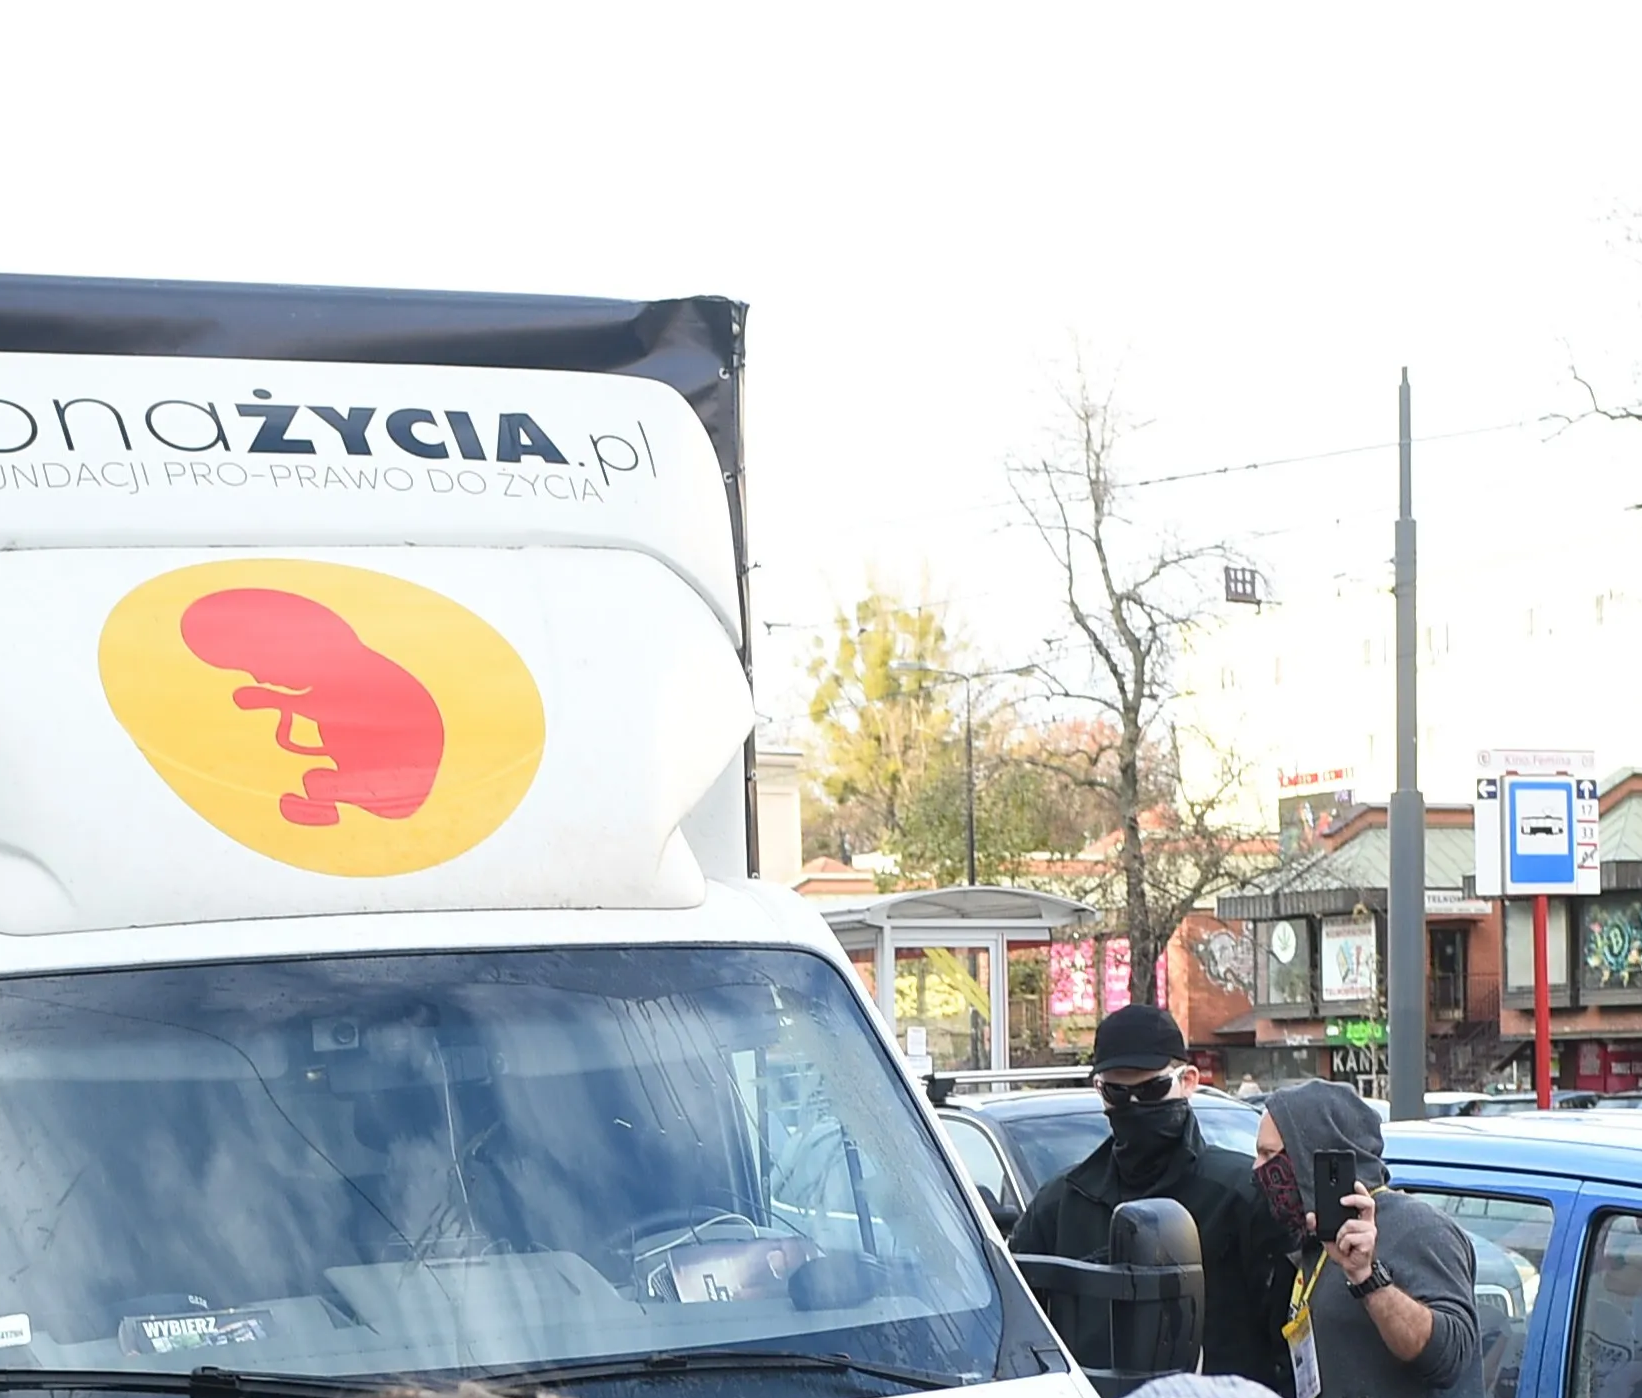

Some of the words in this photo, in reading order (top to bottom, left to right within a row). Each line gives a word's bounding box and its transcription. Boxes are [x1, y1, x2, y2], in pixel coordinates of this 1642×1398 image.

[163, 461, 414, 492] PRO-PRAWO
[427, 468, 488, 495] DO
[496, 466, 605, 504] ŻYCIA
[1581, 804, 1593, 816] 17
[142, 1316, 218, 1338] WYBIERZ
